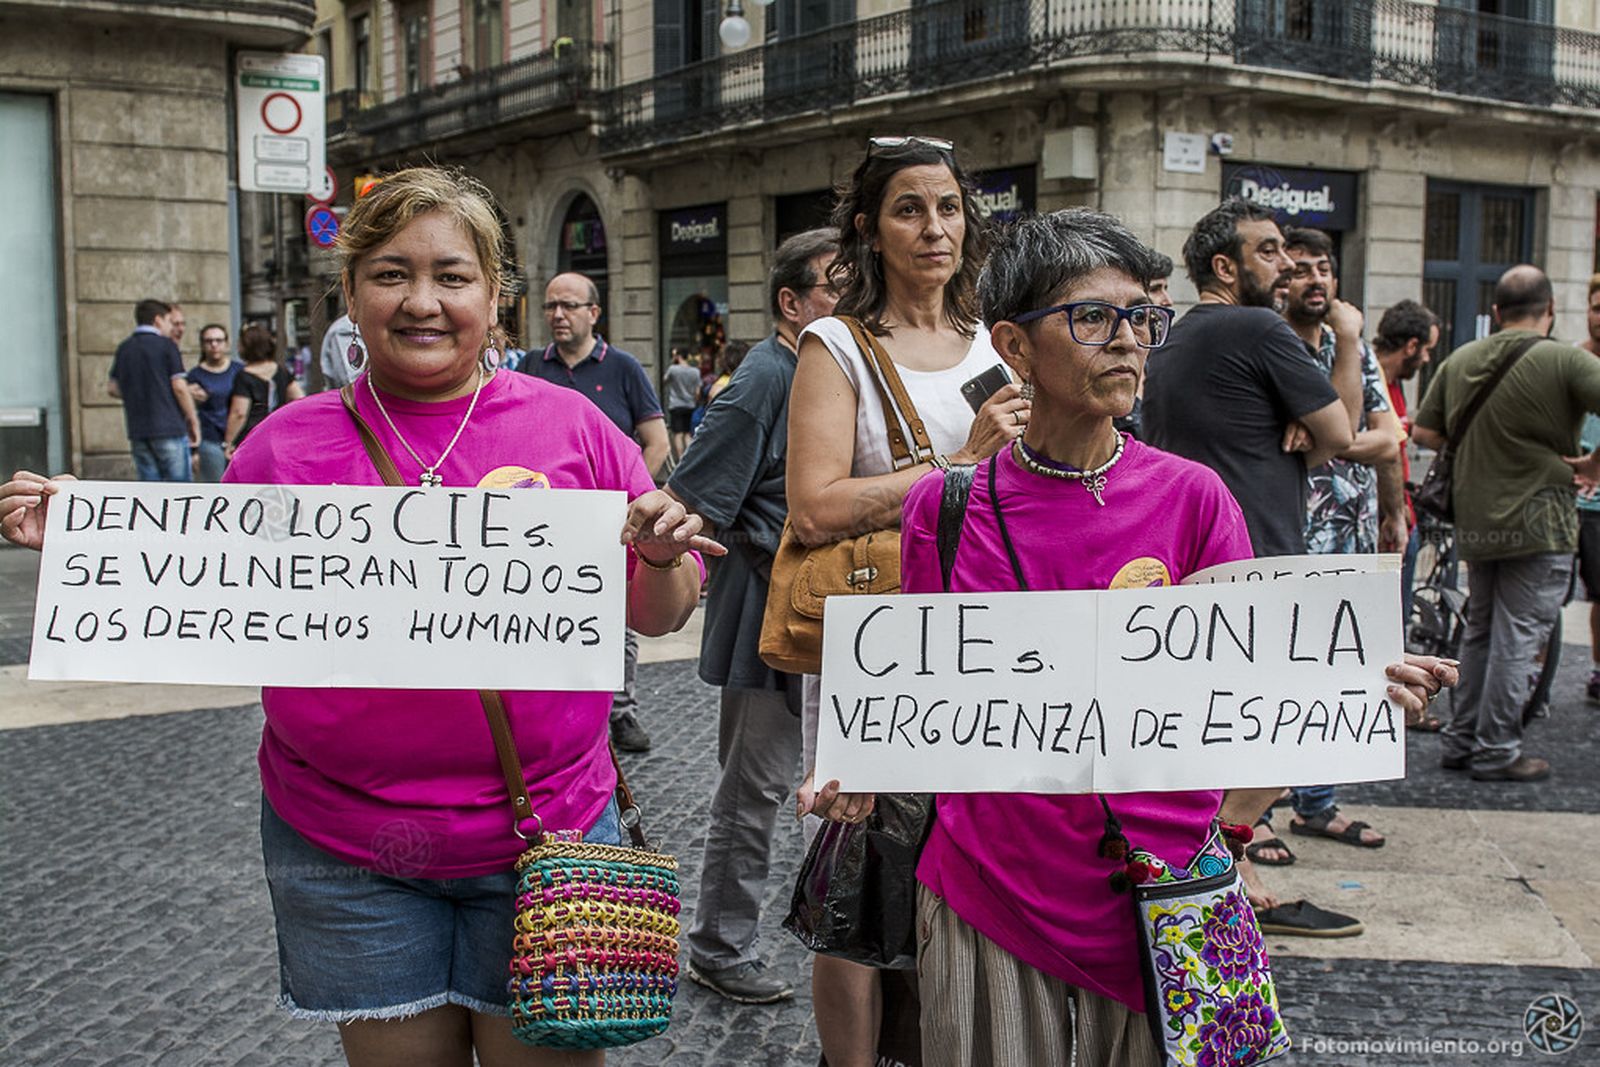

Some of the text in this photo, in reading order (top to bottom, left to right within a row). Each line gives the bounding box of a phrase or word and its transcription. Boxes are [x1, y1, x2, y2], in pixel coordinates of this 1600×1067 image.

[65, 494, 264, 536] DENTRO
[289, 498, 372, 544] LOS
[62, 551, 603, 597] SE VULNERAN TODOS
[46, 604, 600, 646] LOS DERECHOS HUMANOS
[1121, 602, 1254, 663] SON
[1289, 599, 1366, 667] LA
[831, 689, 1397, 757] VERGUENZA DE ESPAÑA
